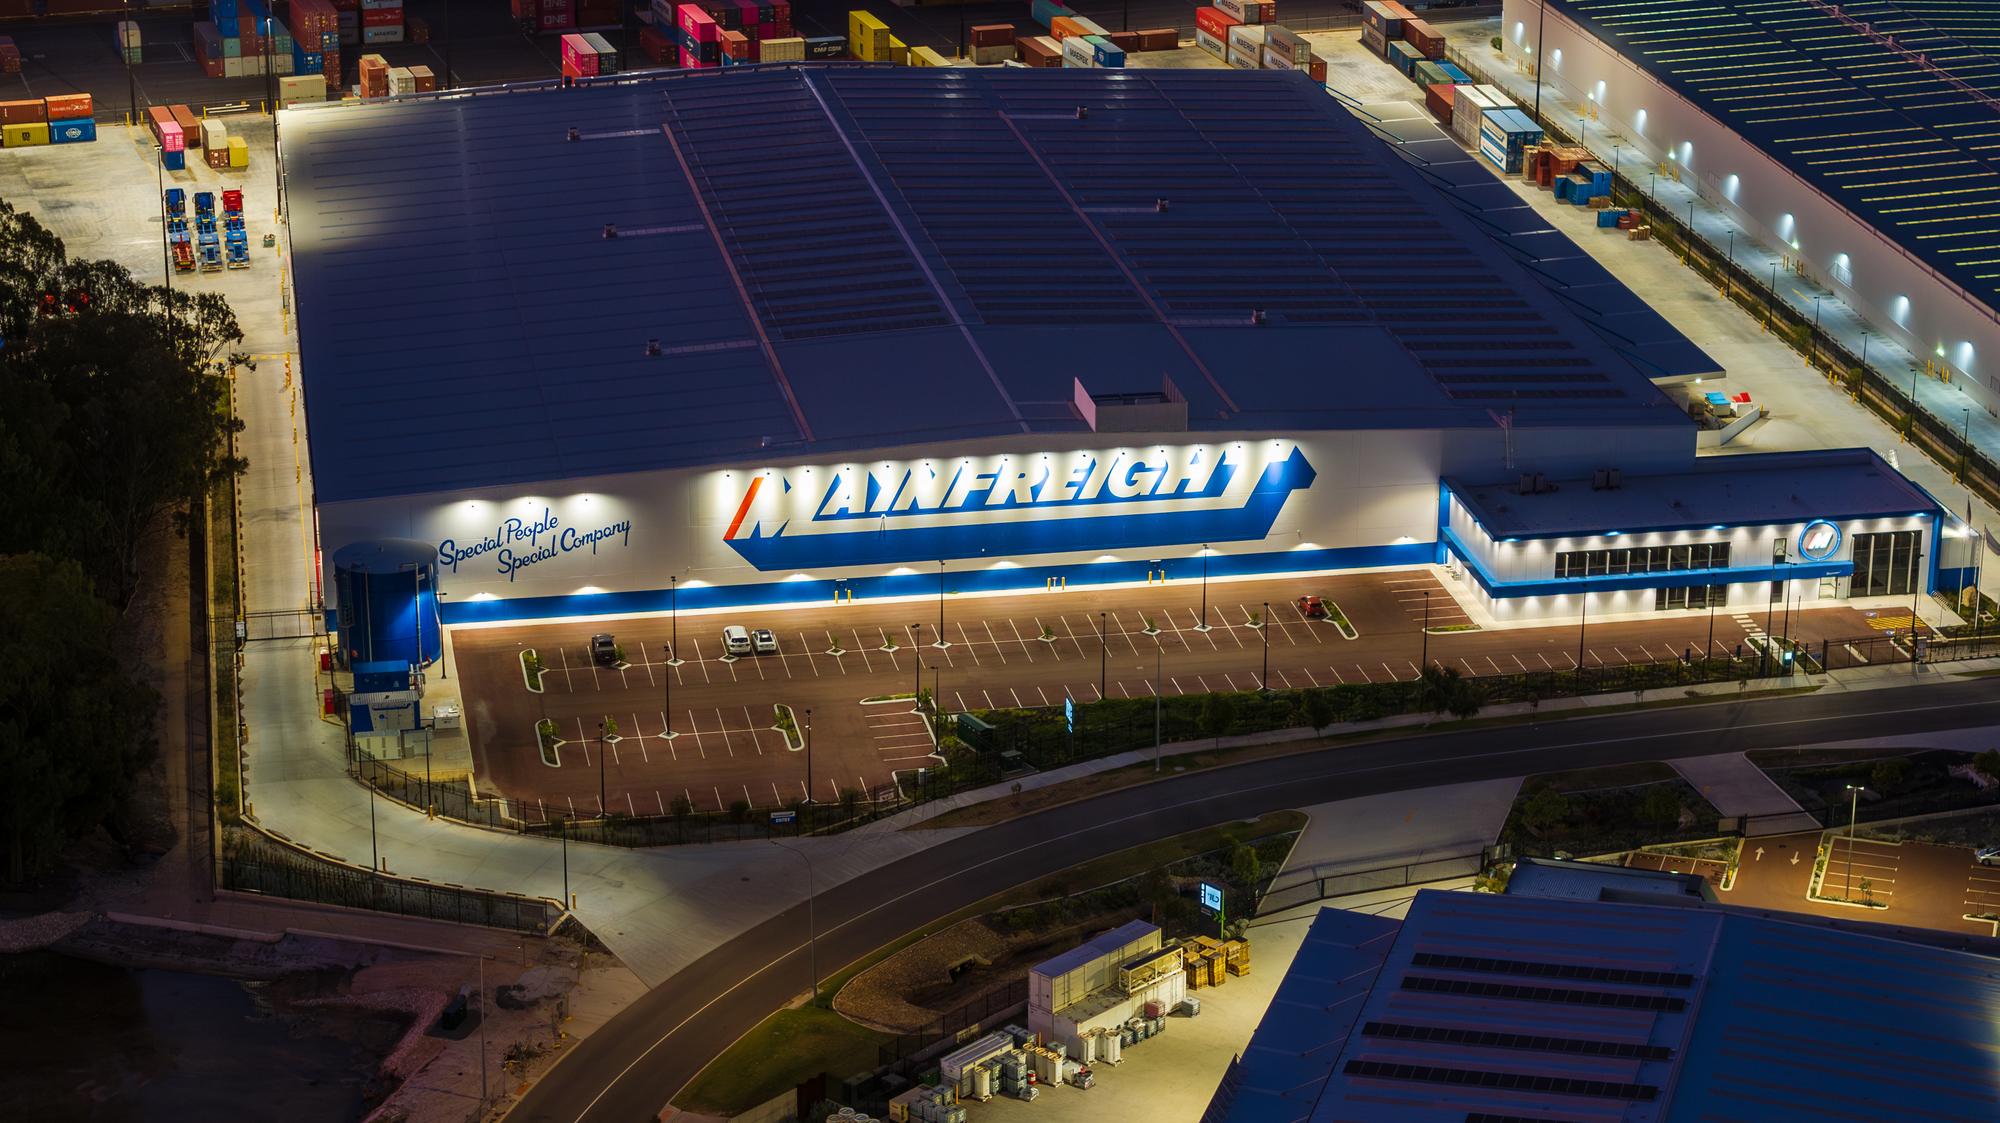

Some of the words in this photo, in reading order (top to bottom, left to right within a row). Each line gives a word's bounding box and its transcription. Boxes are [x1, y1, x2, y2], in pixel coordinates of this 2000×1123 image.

[544, 14, 568, 25] ONE
[723, 444, 1296, 541] MAINFREIGHT
[439, 526, 504, 573] Special
[504, 507, 559, 547] People
[497, 534, 558, 582] Special
[560, 520, 632, 555] Company
